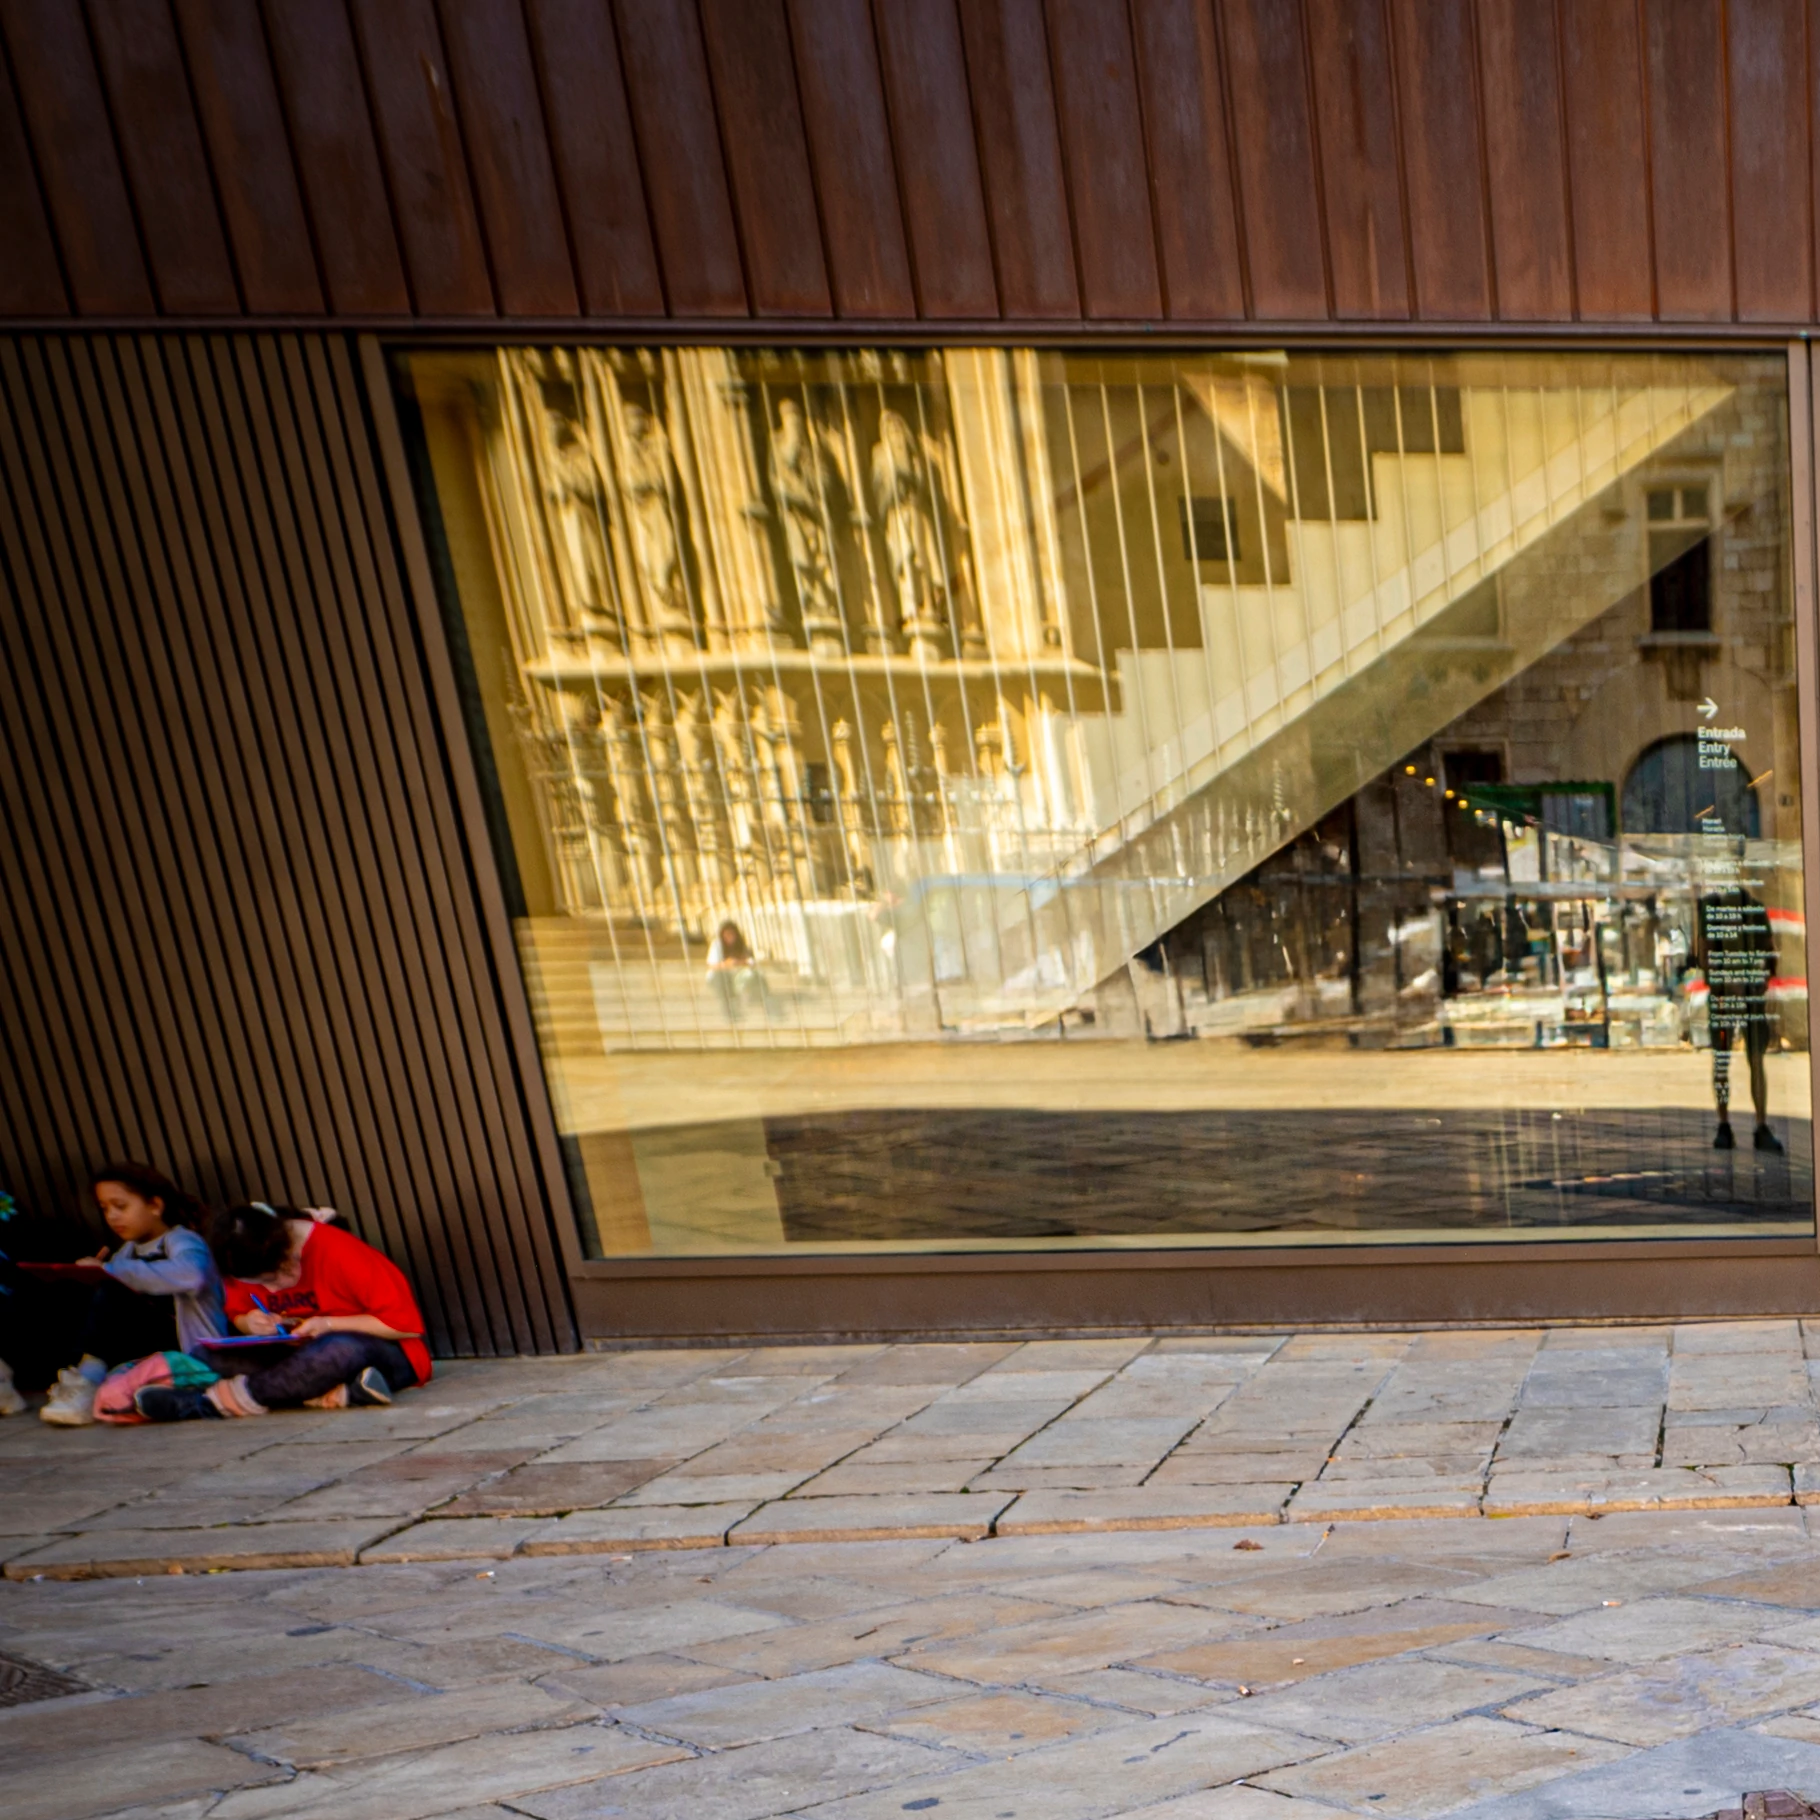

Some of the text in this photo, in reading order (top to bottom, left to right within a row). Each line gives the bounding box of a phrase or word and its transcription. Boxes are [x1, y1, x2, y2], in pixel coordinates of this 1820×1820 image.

[1697, 726, 1747, 740] Entrada
[1698, 741, 1731, 756] Entry
[1699, 756, 1738, 769] Entrée
